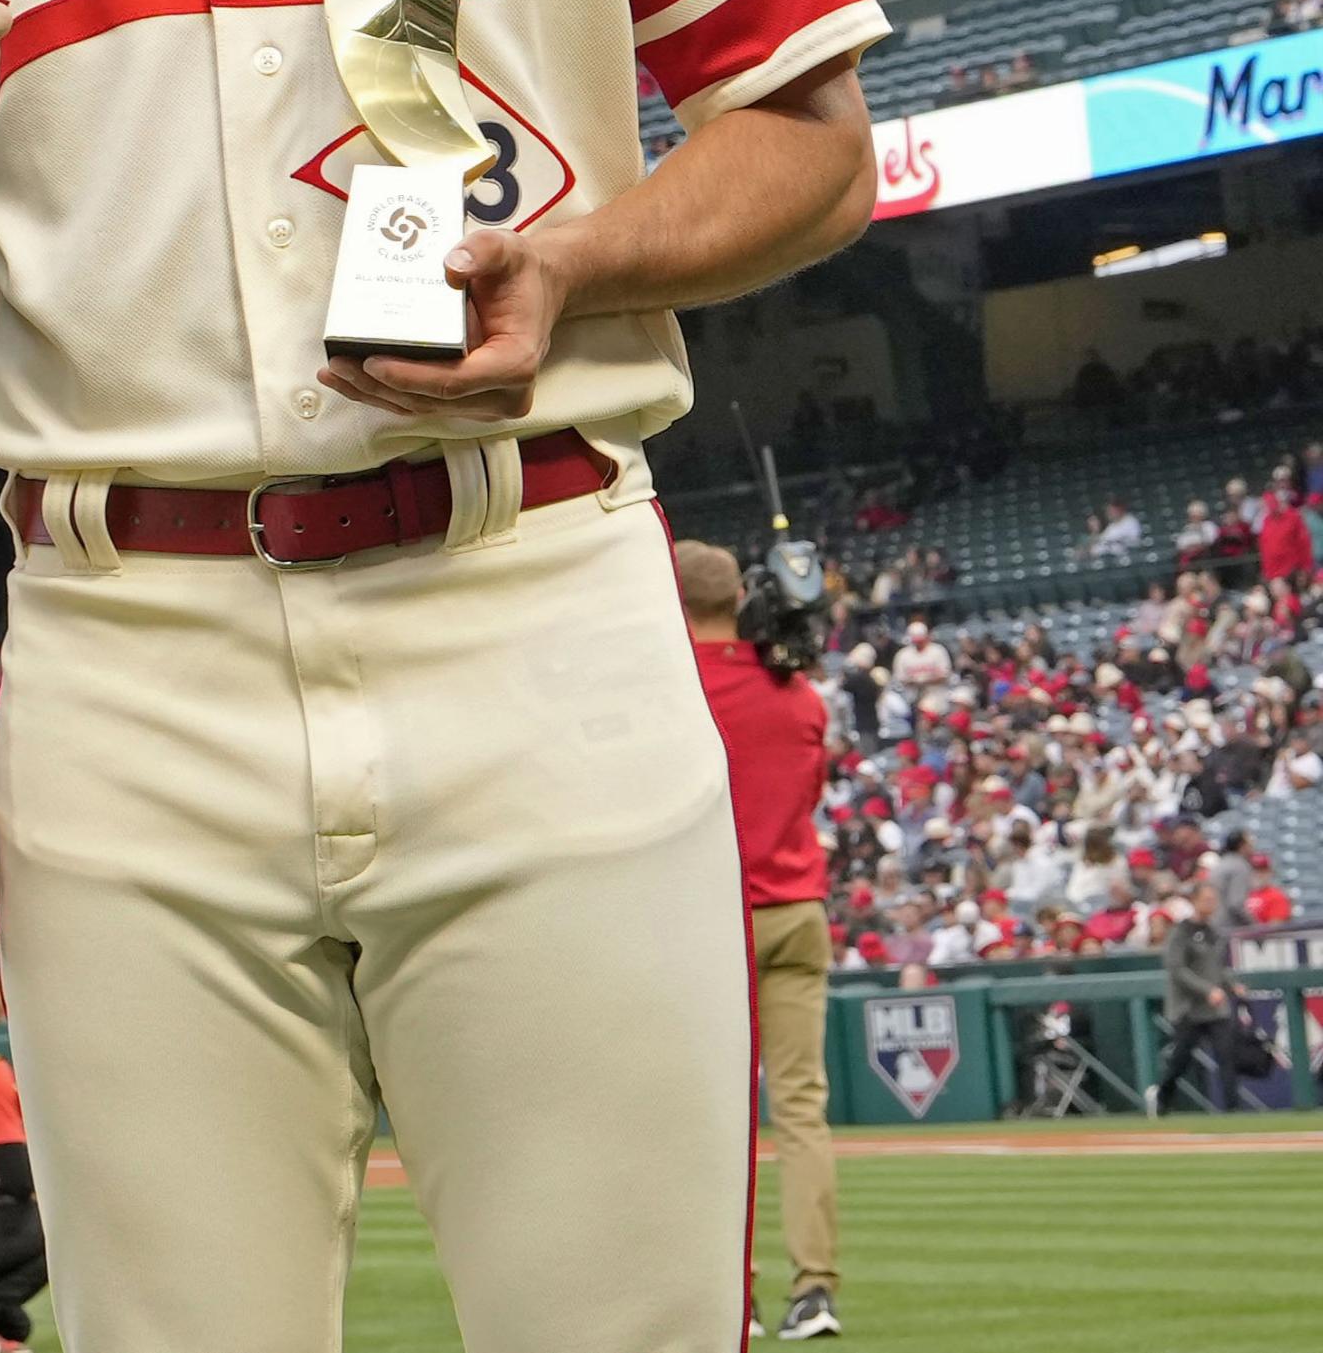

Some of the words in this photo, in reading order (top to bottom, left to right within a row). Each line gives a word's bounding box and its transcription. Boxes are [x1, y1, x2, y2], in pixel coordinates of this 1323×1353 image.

[465, 122, 517, 224] 3
[367, 196, 395, 232] WORLD
[398, 194, 440, 234] BASEBALL
[378, 248, 425, 262] CLASSIC
[875, 1004, 951, 1038] MLB
